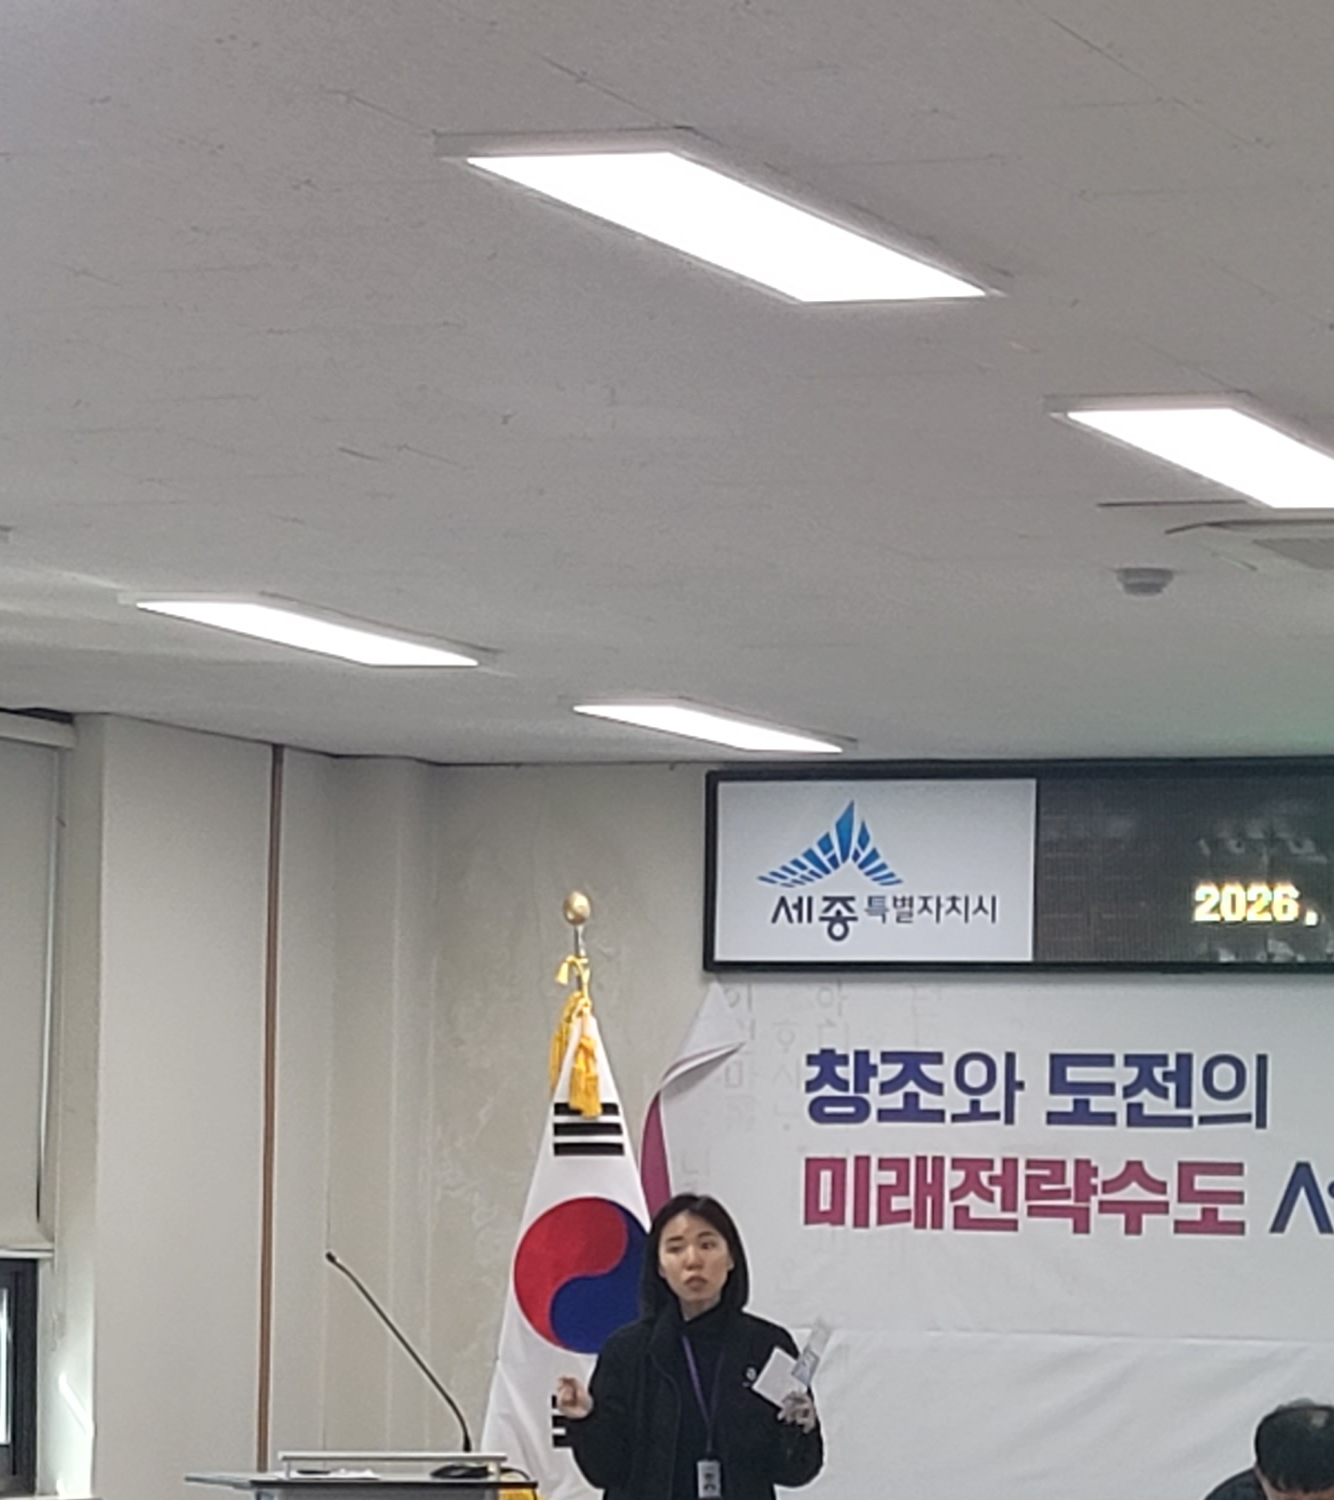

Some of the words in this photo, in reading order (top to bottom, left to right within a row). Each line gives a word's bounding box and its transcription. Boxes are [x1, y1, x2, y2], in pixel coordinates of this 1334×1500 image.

[803, 1047, 1027, 1127] 창조와
[1045, 1050, 1270, 1131] 도전의
[803, 1154, 1247, 1236] 미래전략수도
